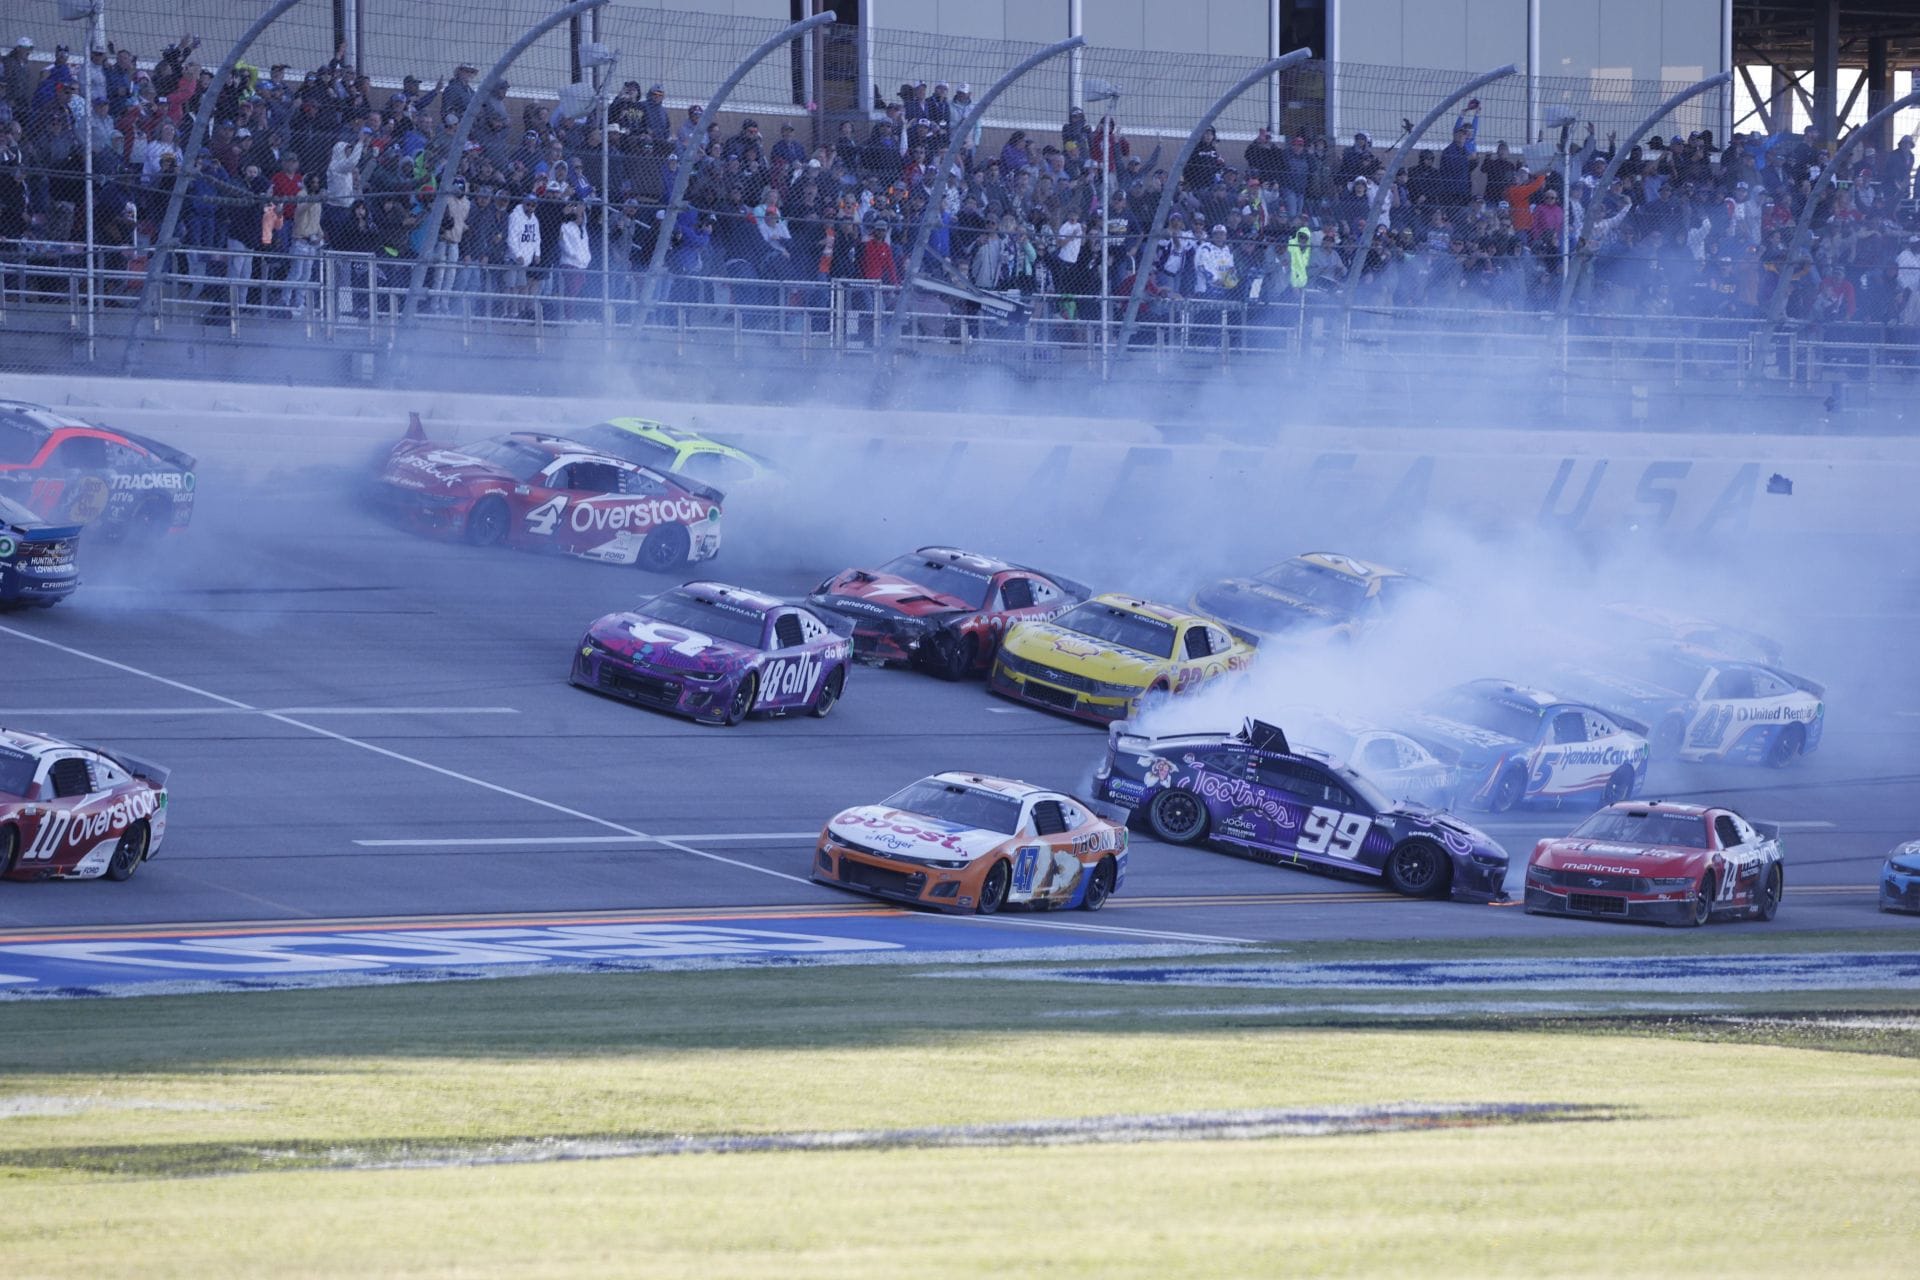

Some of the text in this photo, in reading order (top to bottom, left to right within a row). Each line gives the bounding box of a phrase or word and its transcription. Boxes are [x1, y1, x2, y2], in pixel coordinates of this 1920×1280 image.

[109, 473, 182, 490] TRACKER
[1537, 458, 1761, 535] USA
[524, 495, 571, 536] 4
[571, 497, 705, 533] Overstock
[604, 551, 626, 560] FORD
[715, 602, 758, 618] BOWMAN
[836, 599, 885, 614] gener8tor
[1133, 614, 1168, 629] LOGANO
[757, 651, 822, 705] 48 ally
[1750, 707, 1781, 721] United
[1527, 752, 1559, 793] 5
[22, 808, 71, 861] 10
[68, 789, 159, 847] Overstock
[1222, 817, 1257, 830] JOCKEY
[1296, 805, 1373, 861] 99
[1013, 846, 1041, 894] 47
[1562, 862, 1640, 875] mahindra
